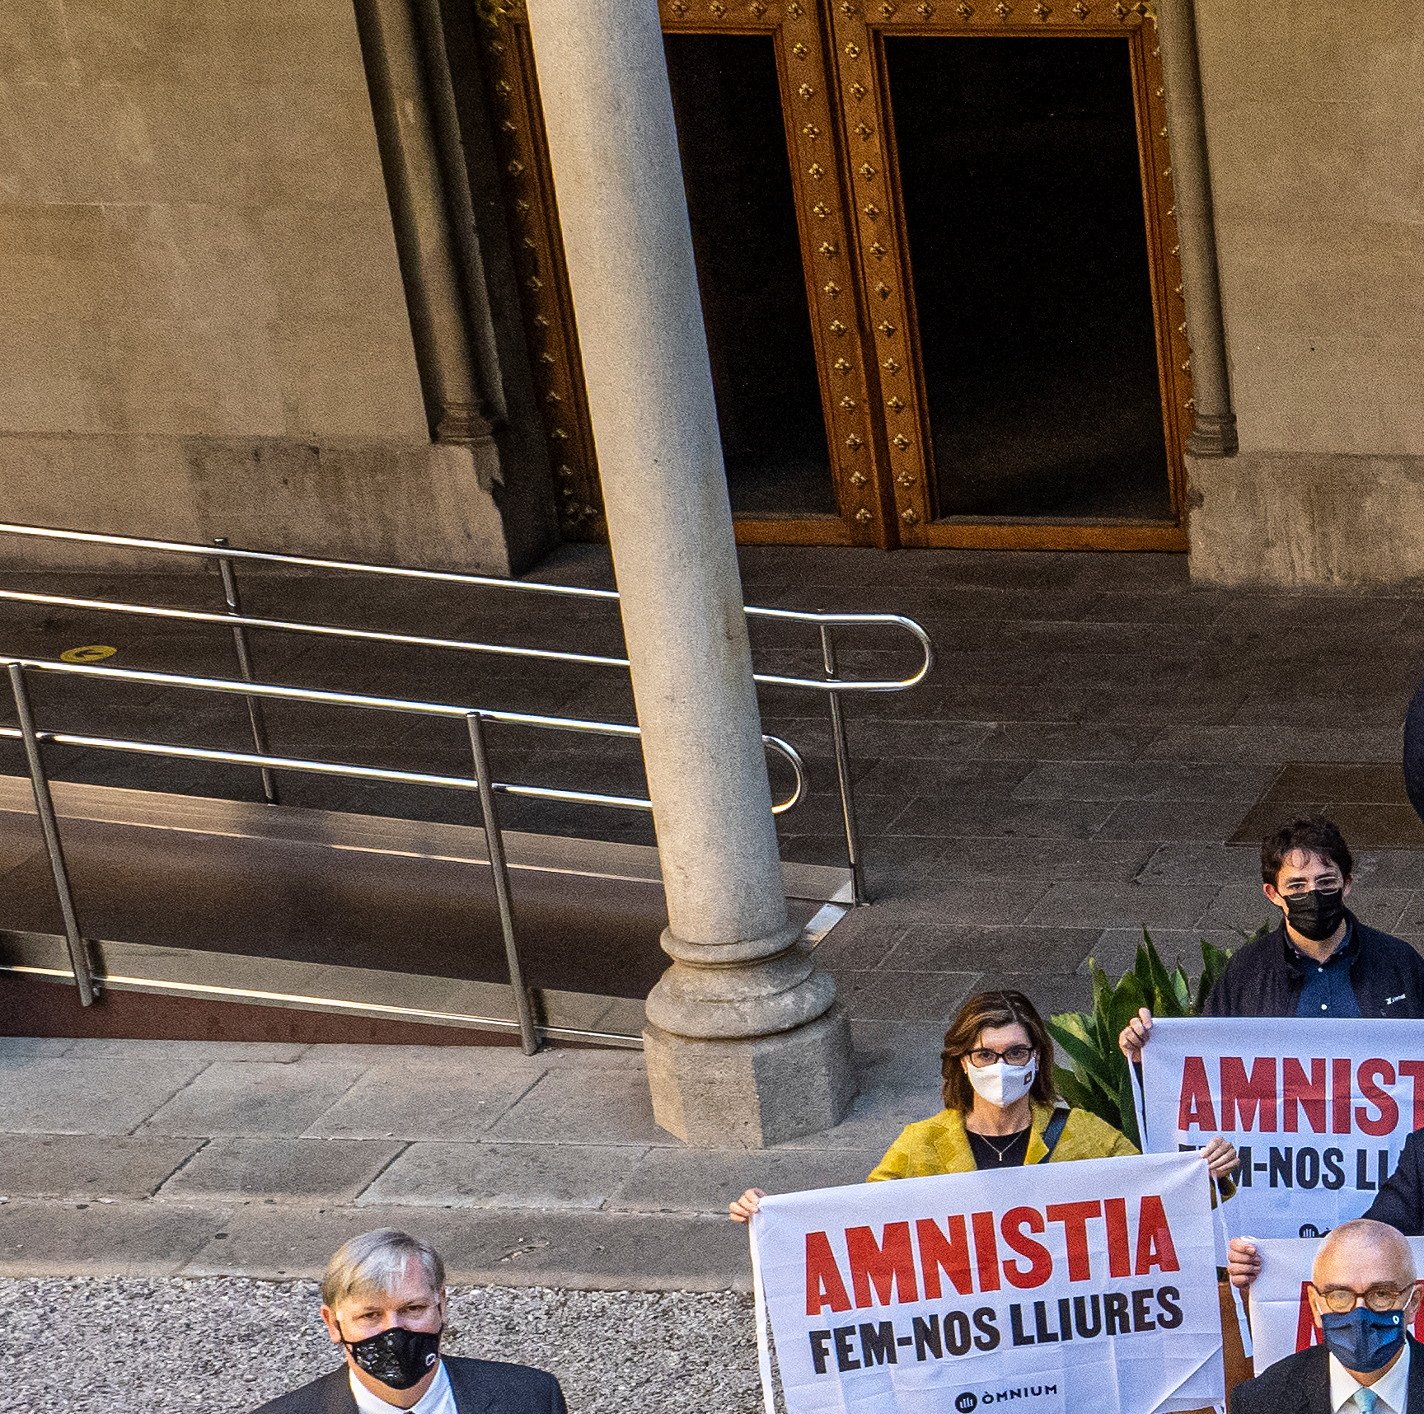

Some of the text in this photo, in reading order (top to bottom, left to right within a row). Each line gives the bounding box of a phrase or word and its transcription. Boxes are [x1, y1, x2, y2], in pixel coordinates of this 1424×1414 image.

[805, 1194, 1181, 1316] AMNISTIA
[809, 1285, 1184, 1375] FEM-NOS LLIURES
[982, 1384, 1058, 1404] ÒMNIUM
